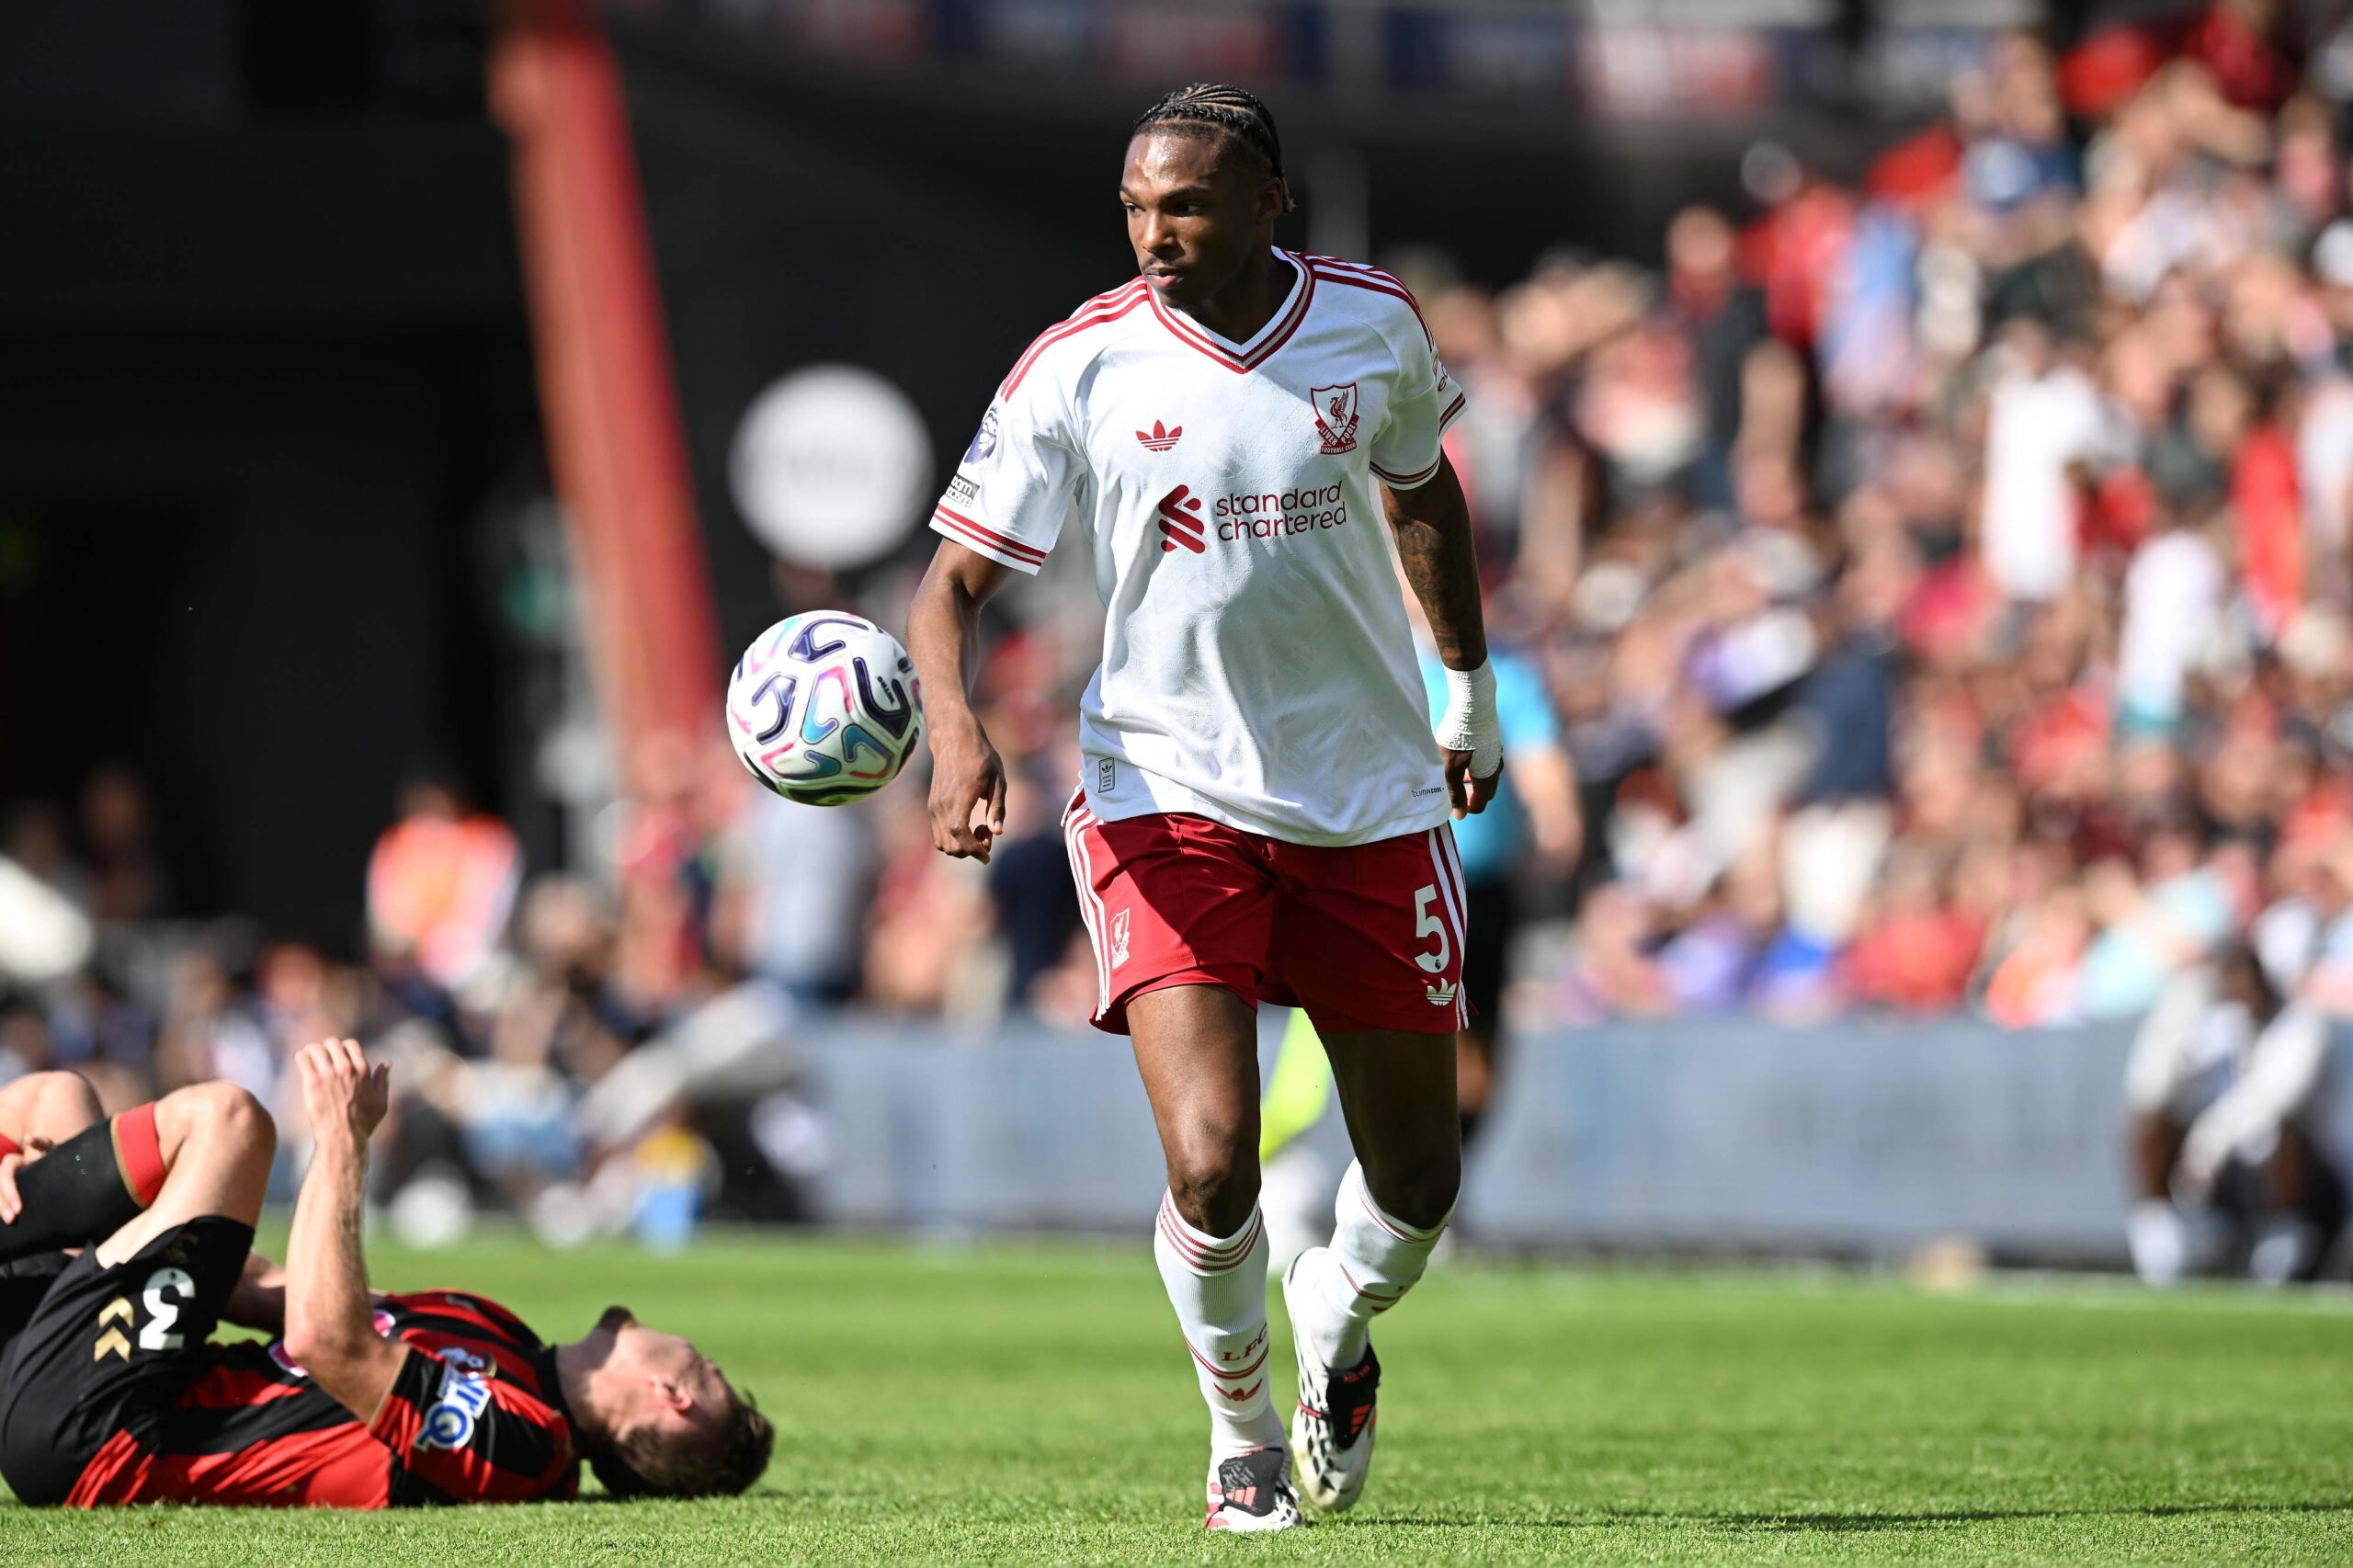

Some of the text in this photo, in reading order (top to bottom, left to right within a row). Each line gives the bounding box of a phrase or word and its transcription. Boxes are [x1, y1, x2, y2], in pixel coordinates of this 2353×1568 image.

[1320, 426, 1338, 446] LIVER
[1340, 421, 1357, 444] POOL
[1216, 480, 1343, 517] standard
[1218, 501, 1347, 541] chartered
[1414, 883, 1450, 973] 5
[139, 1267, 196, 1350] 3
